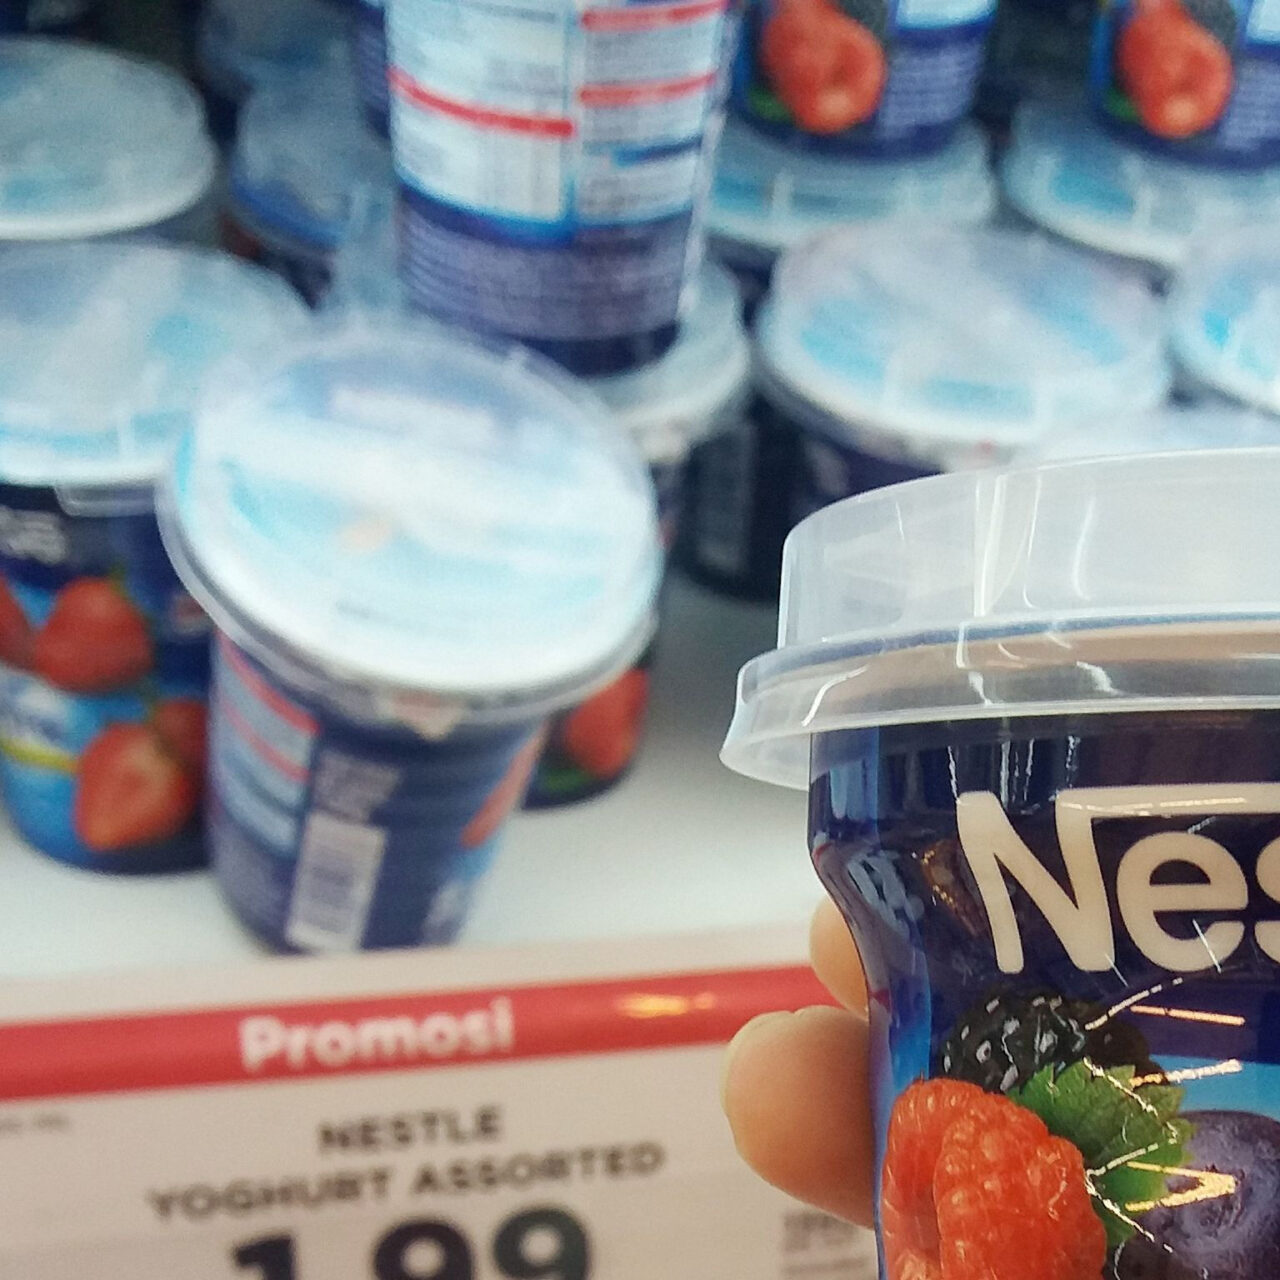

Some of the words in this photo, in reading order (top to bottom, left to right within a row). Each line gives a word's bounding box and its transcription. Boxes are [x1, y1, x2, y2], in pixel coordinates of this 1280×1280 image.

[239, 998, 514, 1072] Promosi
[319, 1105, 502, 1153] NESTLE
[150, 1166, 392, 1220] YOGHURT
[412, 1140, 665, 1196] ASSORTED
